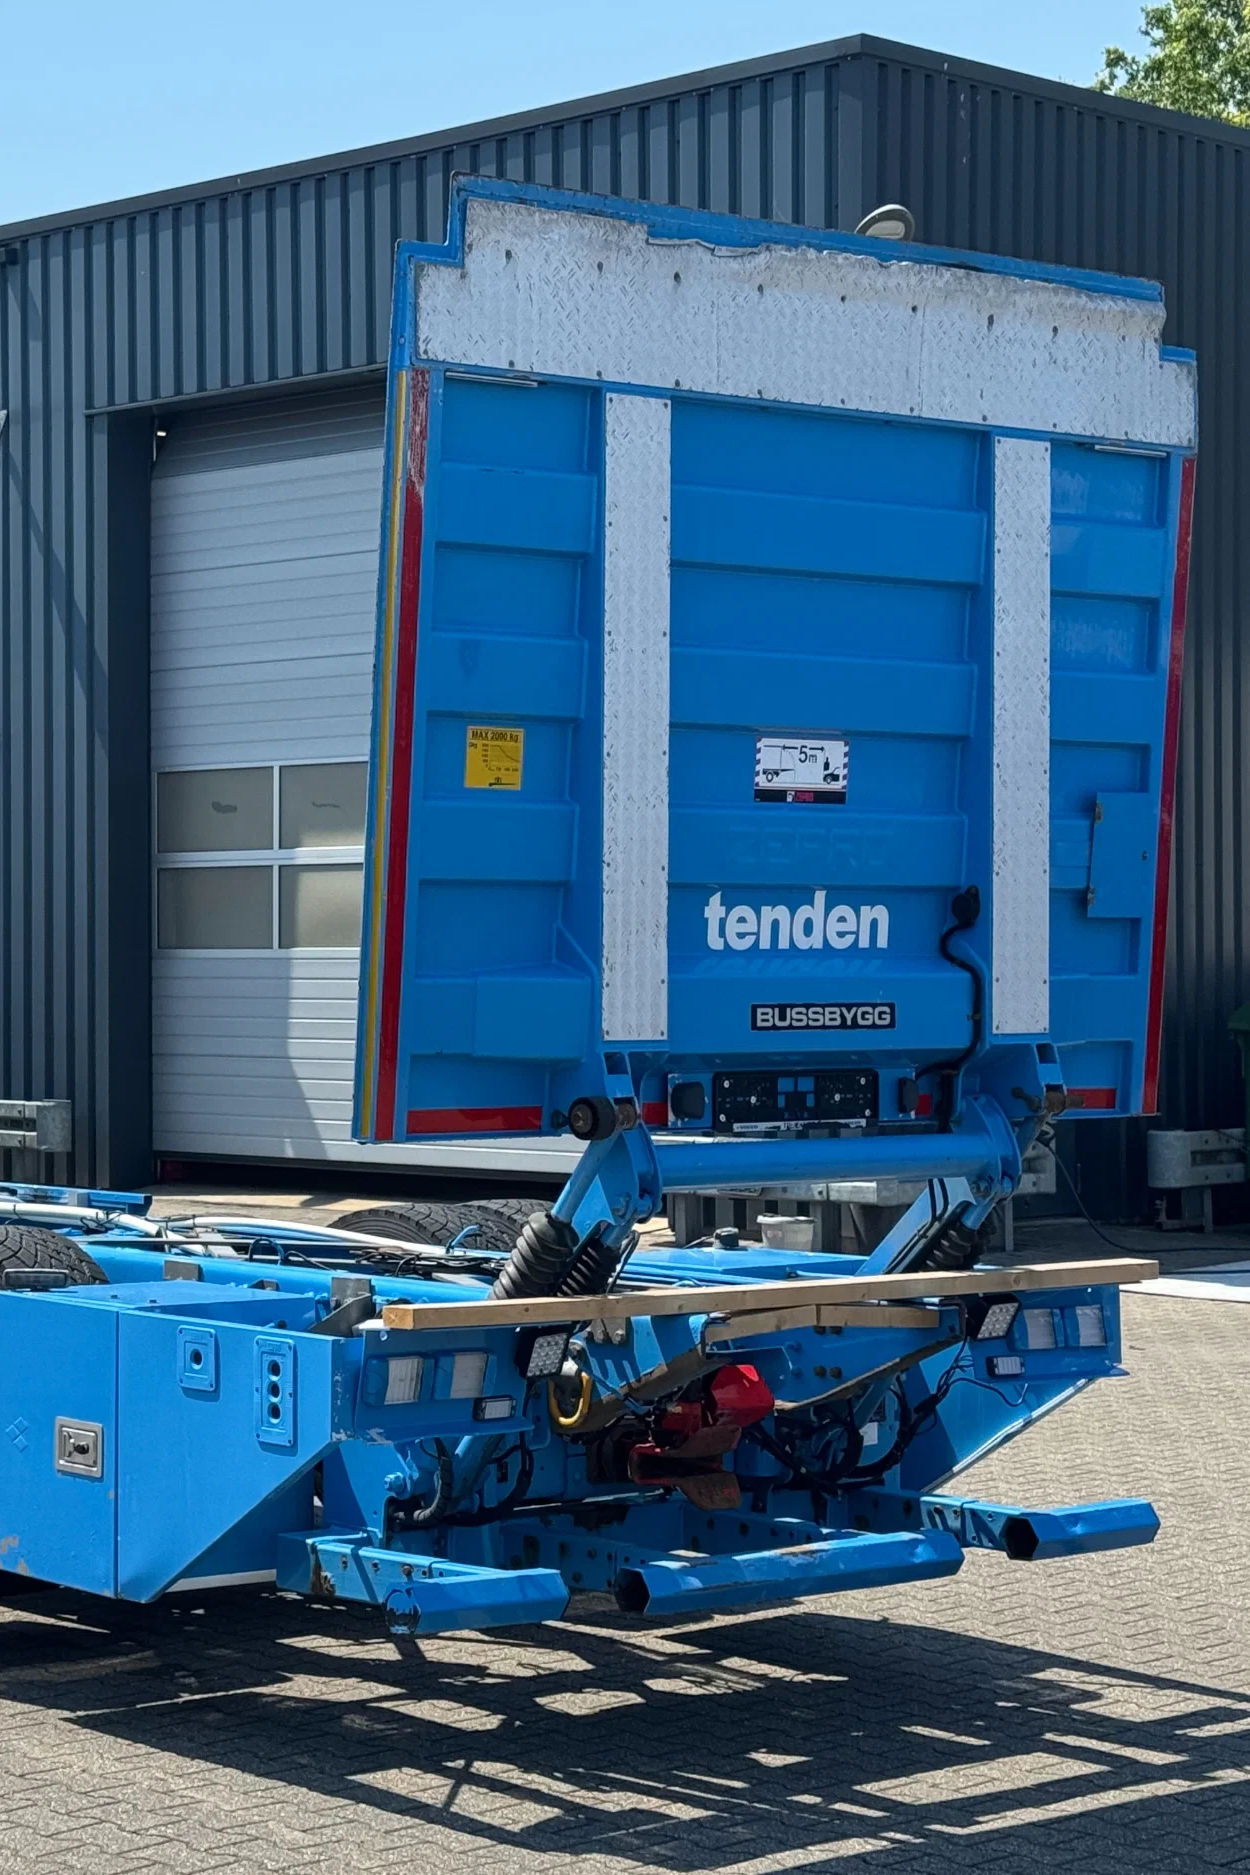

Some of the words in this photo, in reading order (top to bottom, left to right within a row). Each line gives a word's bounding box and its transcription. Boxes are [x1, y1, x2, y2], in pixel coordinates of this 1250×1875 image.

[471, 730, 489, 741] MAX
[704, 890, 890, 951] tenden
[756, 1006, 892, 1027] BUSSBYGG
